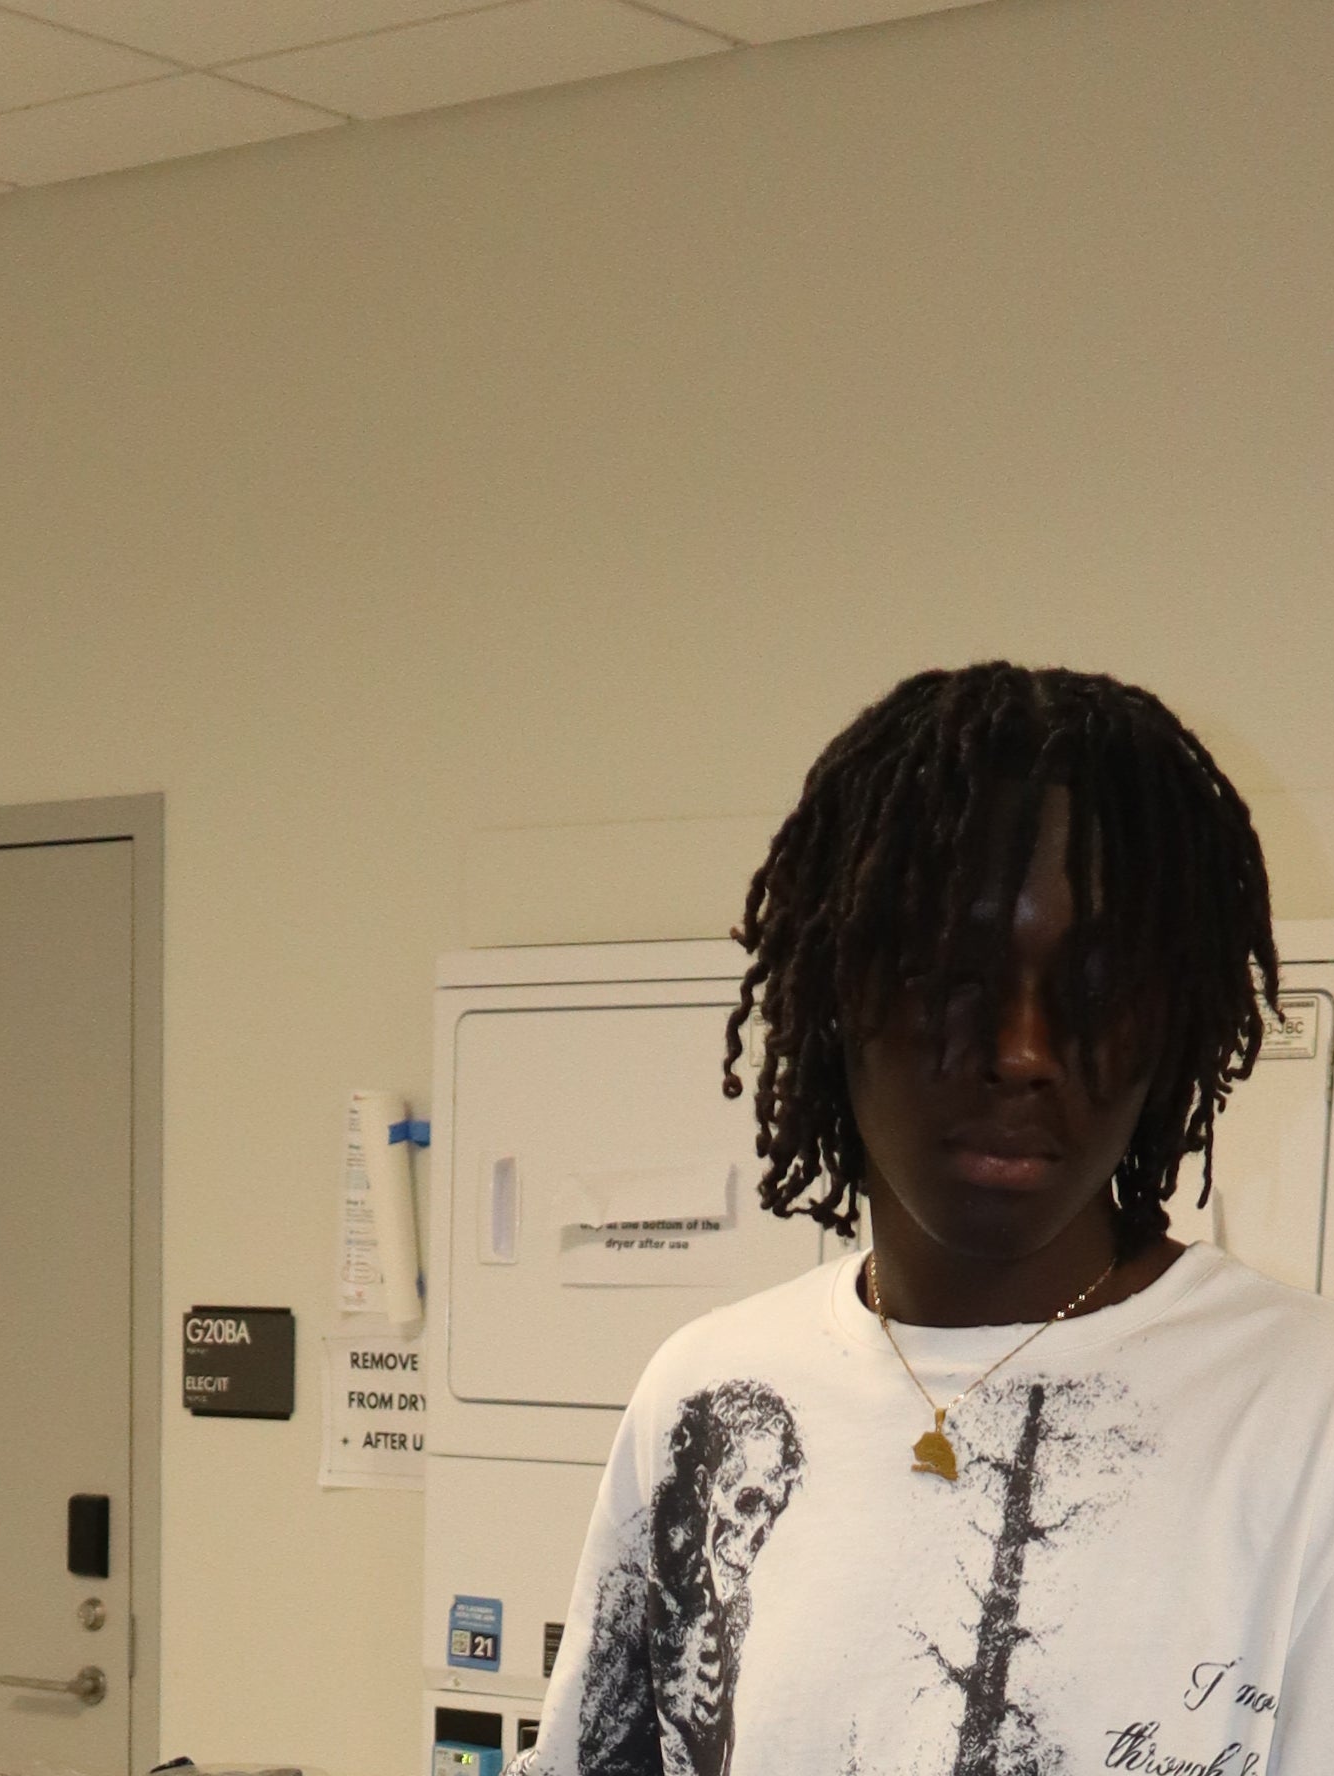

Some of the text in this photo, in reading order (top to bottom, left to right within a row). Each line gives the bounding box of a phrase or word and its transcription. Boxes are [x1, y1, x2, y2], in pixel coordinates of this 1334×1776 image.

[642, 1220, 683, 1231] bottom
[686, 1219, 698, 1230] of
[701, 1218, 721, 1231] the
[605, 1237, 689, 1251] dryer after use
[350, 1352, 419, 1371] REMOVE
[348, 1391, 393, 1411] FROM
[362, 1432, 424, 1452] AFTER U
[473, 1635, 494, 1658] 21
